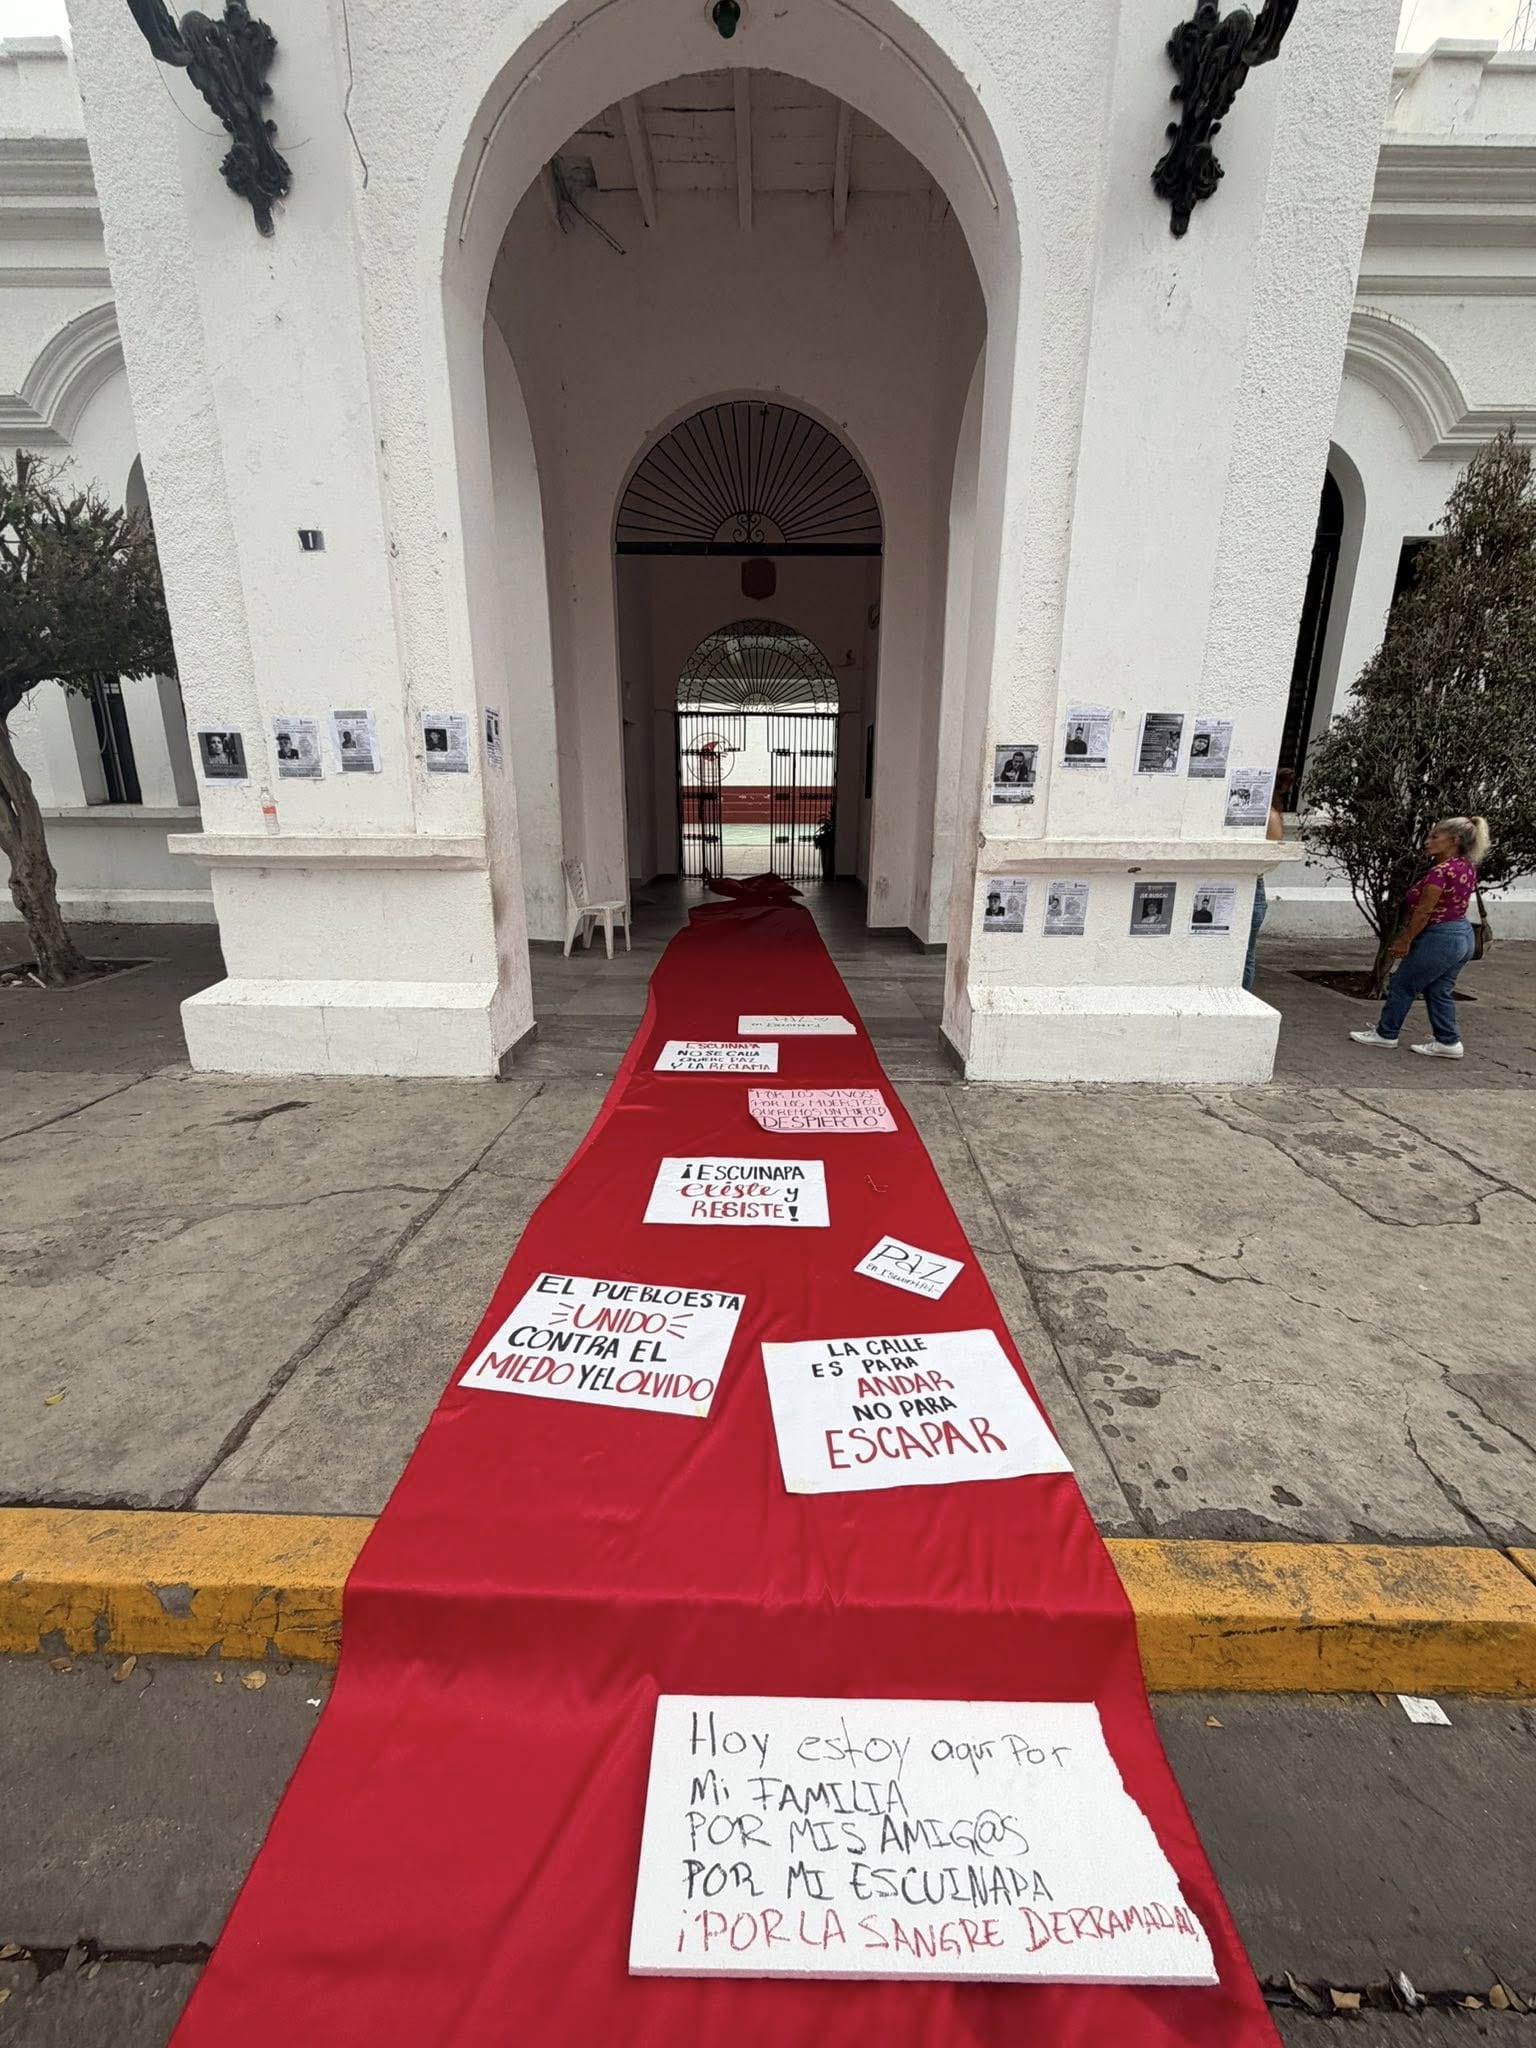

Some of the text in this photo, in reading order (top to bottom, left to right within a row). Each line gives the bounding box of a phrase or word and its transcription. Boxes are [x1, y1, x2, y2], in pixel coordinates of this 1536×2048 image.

[671, 1062, 770, 1071] Y LA RECLAMA
[751, 1099, 880, 1107] POR LOS MUERTOS
[755, 1090, 785, 1098] POR
[791, 1090, 814, 1098] LOS
[752, 1106, 886, 1116] QUEREMOS UN PUEBLO
[763, 1115, 878, 1128] DESPIERTO
[676, 1181, 780, 1198] existe
[536, 1275, 741, 1311] EL PUEBLO ESTA
[572, 1303, 667, 1334] UNIDO
[508, 1325, 667, 1363] CONTRA EL
[827, 1337, 928, 1357] LA CALLE
[475, 1351, 575, 1385] MIEDO
[615, 1370, 715, 1402] OLVIDO
[811, 1356, 919, 1378] ES PARA
[857, 1370, 955, 1398] ANDAR
[852, 1395, 957, 1422] NO PARA
[825, 1417, 1008, 1470] ESCAPAR
[689, 1711, 769, 1769] Hoy
[797, 1716, 910, 1781] estoy
[747, 1777, 910, 1818] FAMILIA
[684, 1809, 1029, 1857] POR MIS AMIG@S
[682, 1859, 1054, 1909] POR MI ESCUINAPA
[799, 1908, 846, 1950] LA
[858, 1914, 1004, 1958] SANGRE
